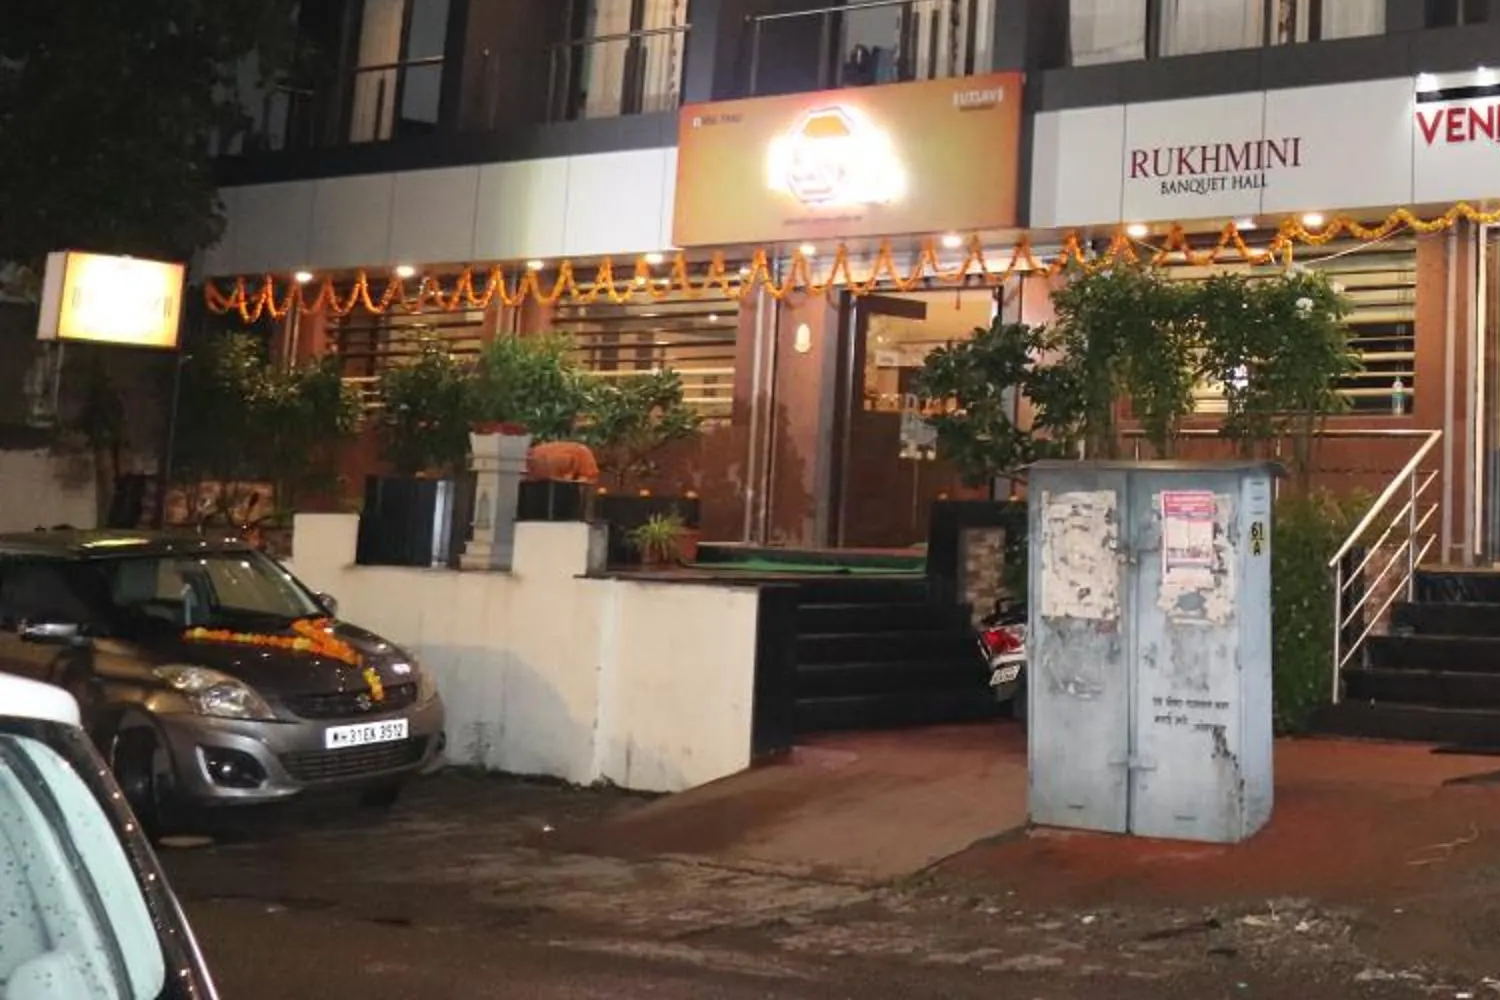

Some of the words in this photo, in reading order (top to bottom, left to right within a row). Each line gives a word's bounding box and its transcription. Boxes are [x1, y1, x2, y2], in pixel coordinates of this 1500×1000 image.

[1130, 138, 1301, 179] RUKHMINI
[1161, 177, 1227, 194] BANQUET
[1232, 173, 1267, 189] HALL
